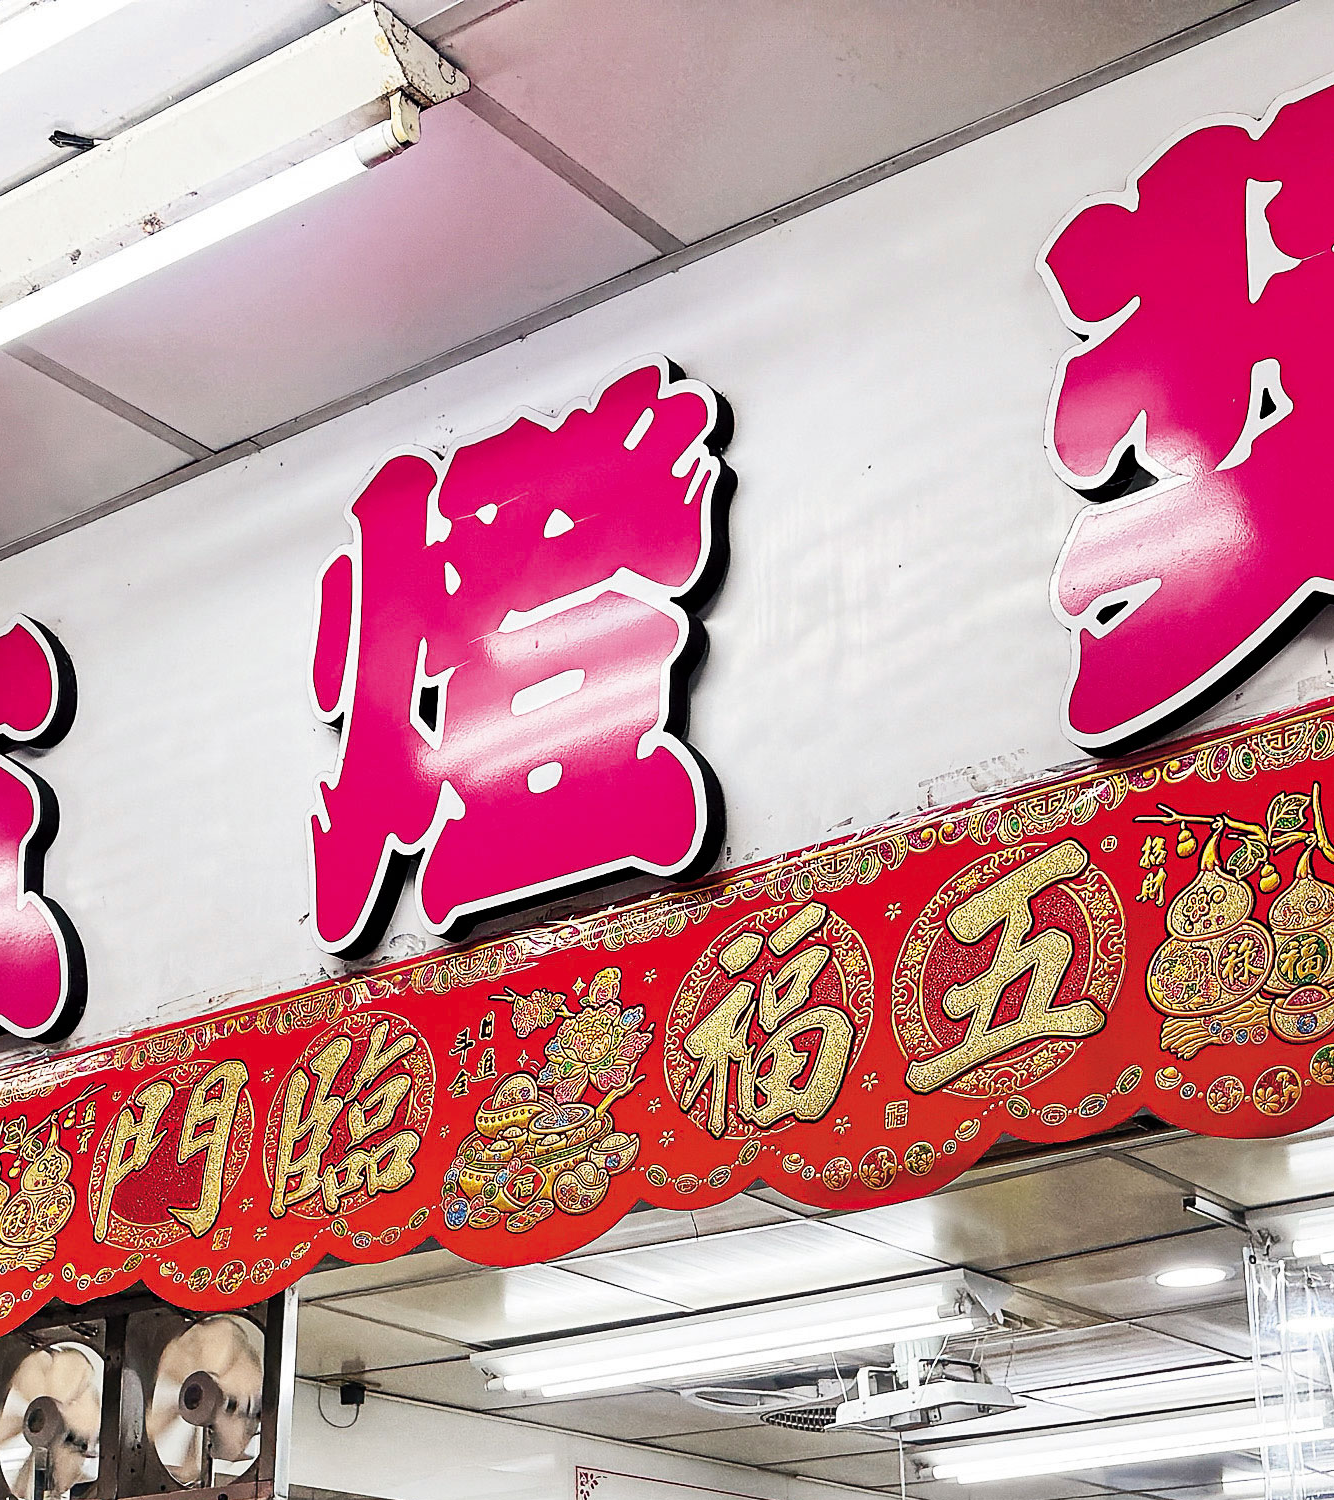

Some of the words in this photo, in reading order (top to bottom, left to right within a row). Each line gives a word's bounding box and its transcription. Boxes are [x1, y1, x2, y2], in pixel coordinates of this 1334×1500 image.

[1136, 836, 1166, 907] 招財
[1222, 937, 1264, 984] 祿
[1277, 936, 1321, 983] 福
